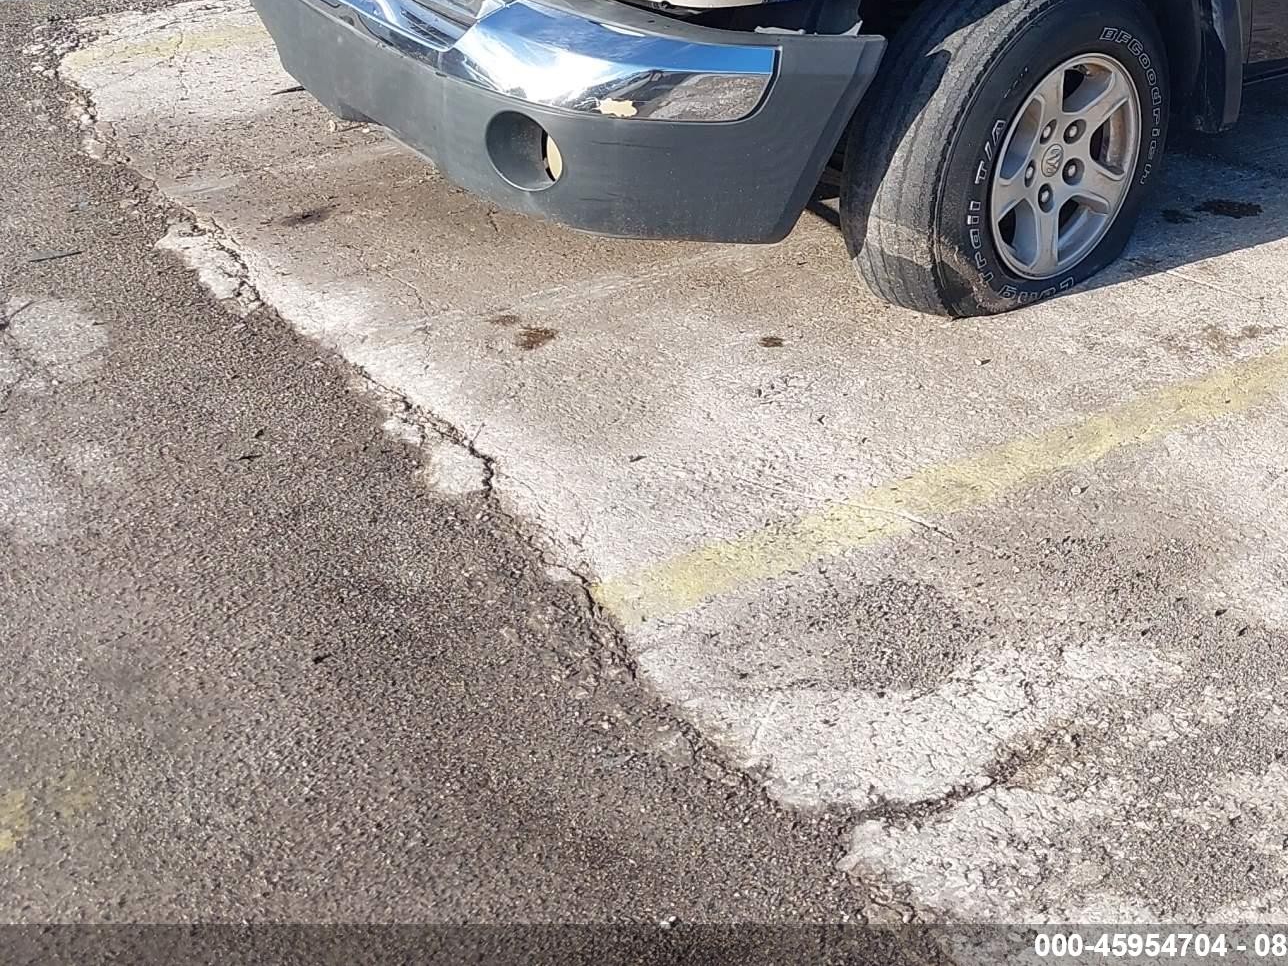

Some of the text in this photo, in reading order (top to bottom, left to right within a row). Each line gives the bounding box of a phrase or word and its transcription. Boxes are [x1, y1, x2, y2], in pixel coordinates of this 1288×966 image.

[1099, 27, 1160, 184] BFGoodrich
[974, 119, 1007, 184] T/A
[966, 200, 995, 286] Trail
